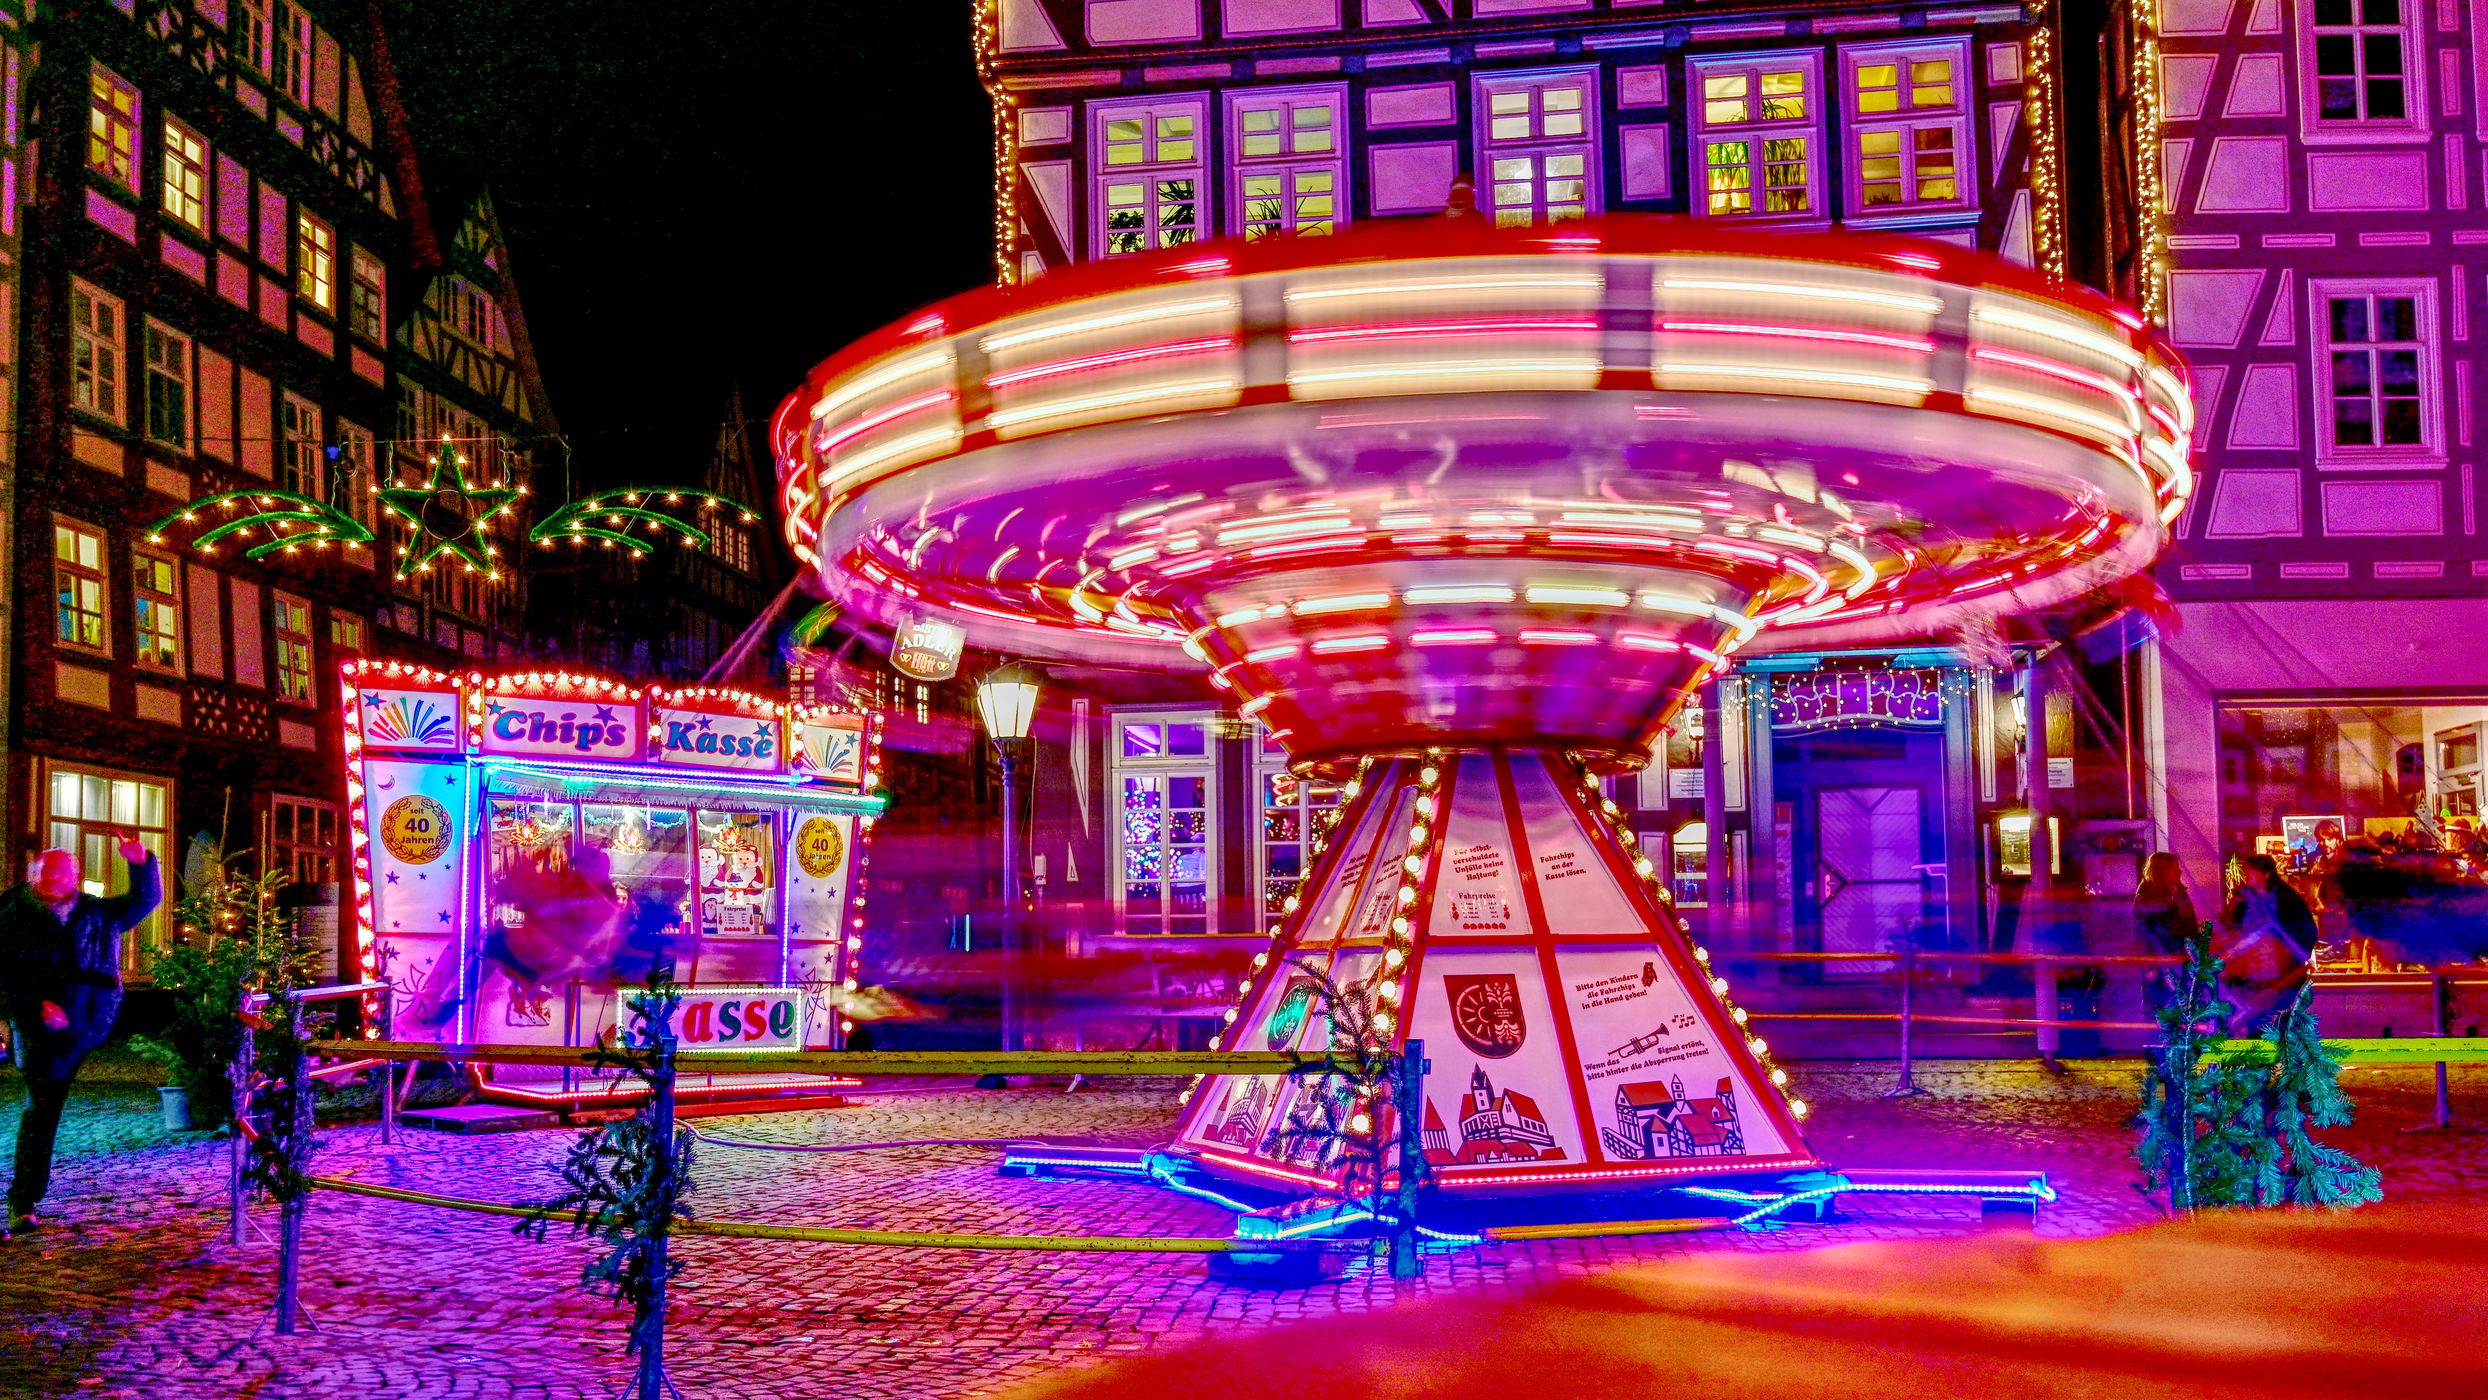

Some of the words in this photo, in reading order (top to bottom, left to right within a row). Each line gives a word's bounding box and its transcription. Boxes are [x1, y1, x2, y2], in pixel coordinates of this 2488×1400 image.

[900, 633, 957, 661] ADLER
[492, 710, 627, 751] Chips
[666, 720, 773, 758] Kasse
[404, 818, 430, 833] 40
[401, 835, 434, 844] Jahren
[811, 838, 829, 852] 40
[1452, 852, 1500, 865] verschuldete
[1539, 851, 1575, 864] Fahrchips
[1454, 863, 1482, 874] Unfälle
[1484, 860, 1504, 870] keine
[1561, 861, 1574, 869] der
[1466, 869, 1500, 881] Haftung!
[1544, 872, 1566, 881] Kasse
[1566, 868, 1587, 878] lösen.
[1458, 892, 1496, 900] Fahrpreise
[1575, 983, 1594, 992] Bitte
[1595, 979, 1609, 988] den
[1609, 973, 1639, 984] Kindern
[1599, 984, 1636, 996] Fahrchips
[1591, 999, 1603, 1007] die
[1604, 995, 1624, 1005] Hand
[1624, 989, 1648, 1002] geben!
[1584, 1063, 1606, 1072] Wenn
[1607, 1058, 1620, 1066] das
[1657, 1046, 1680, 1055] Signal
[1681, 1040, 1705, 1050] ertönt,
[1586, 1072, 1605, 1081] bitte
[1606, 1066, 1629, 1077] hinter
[1630, 1062, 1642, 1070] die
[1643, 1053, 1686, 1068] Absperrung
[1686, 1048, 1710, 1059] treten!
